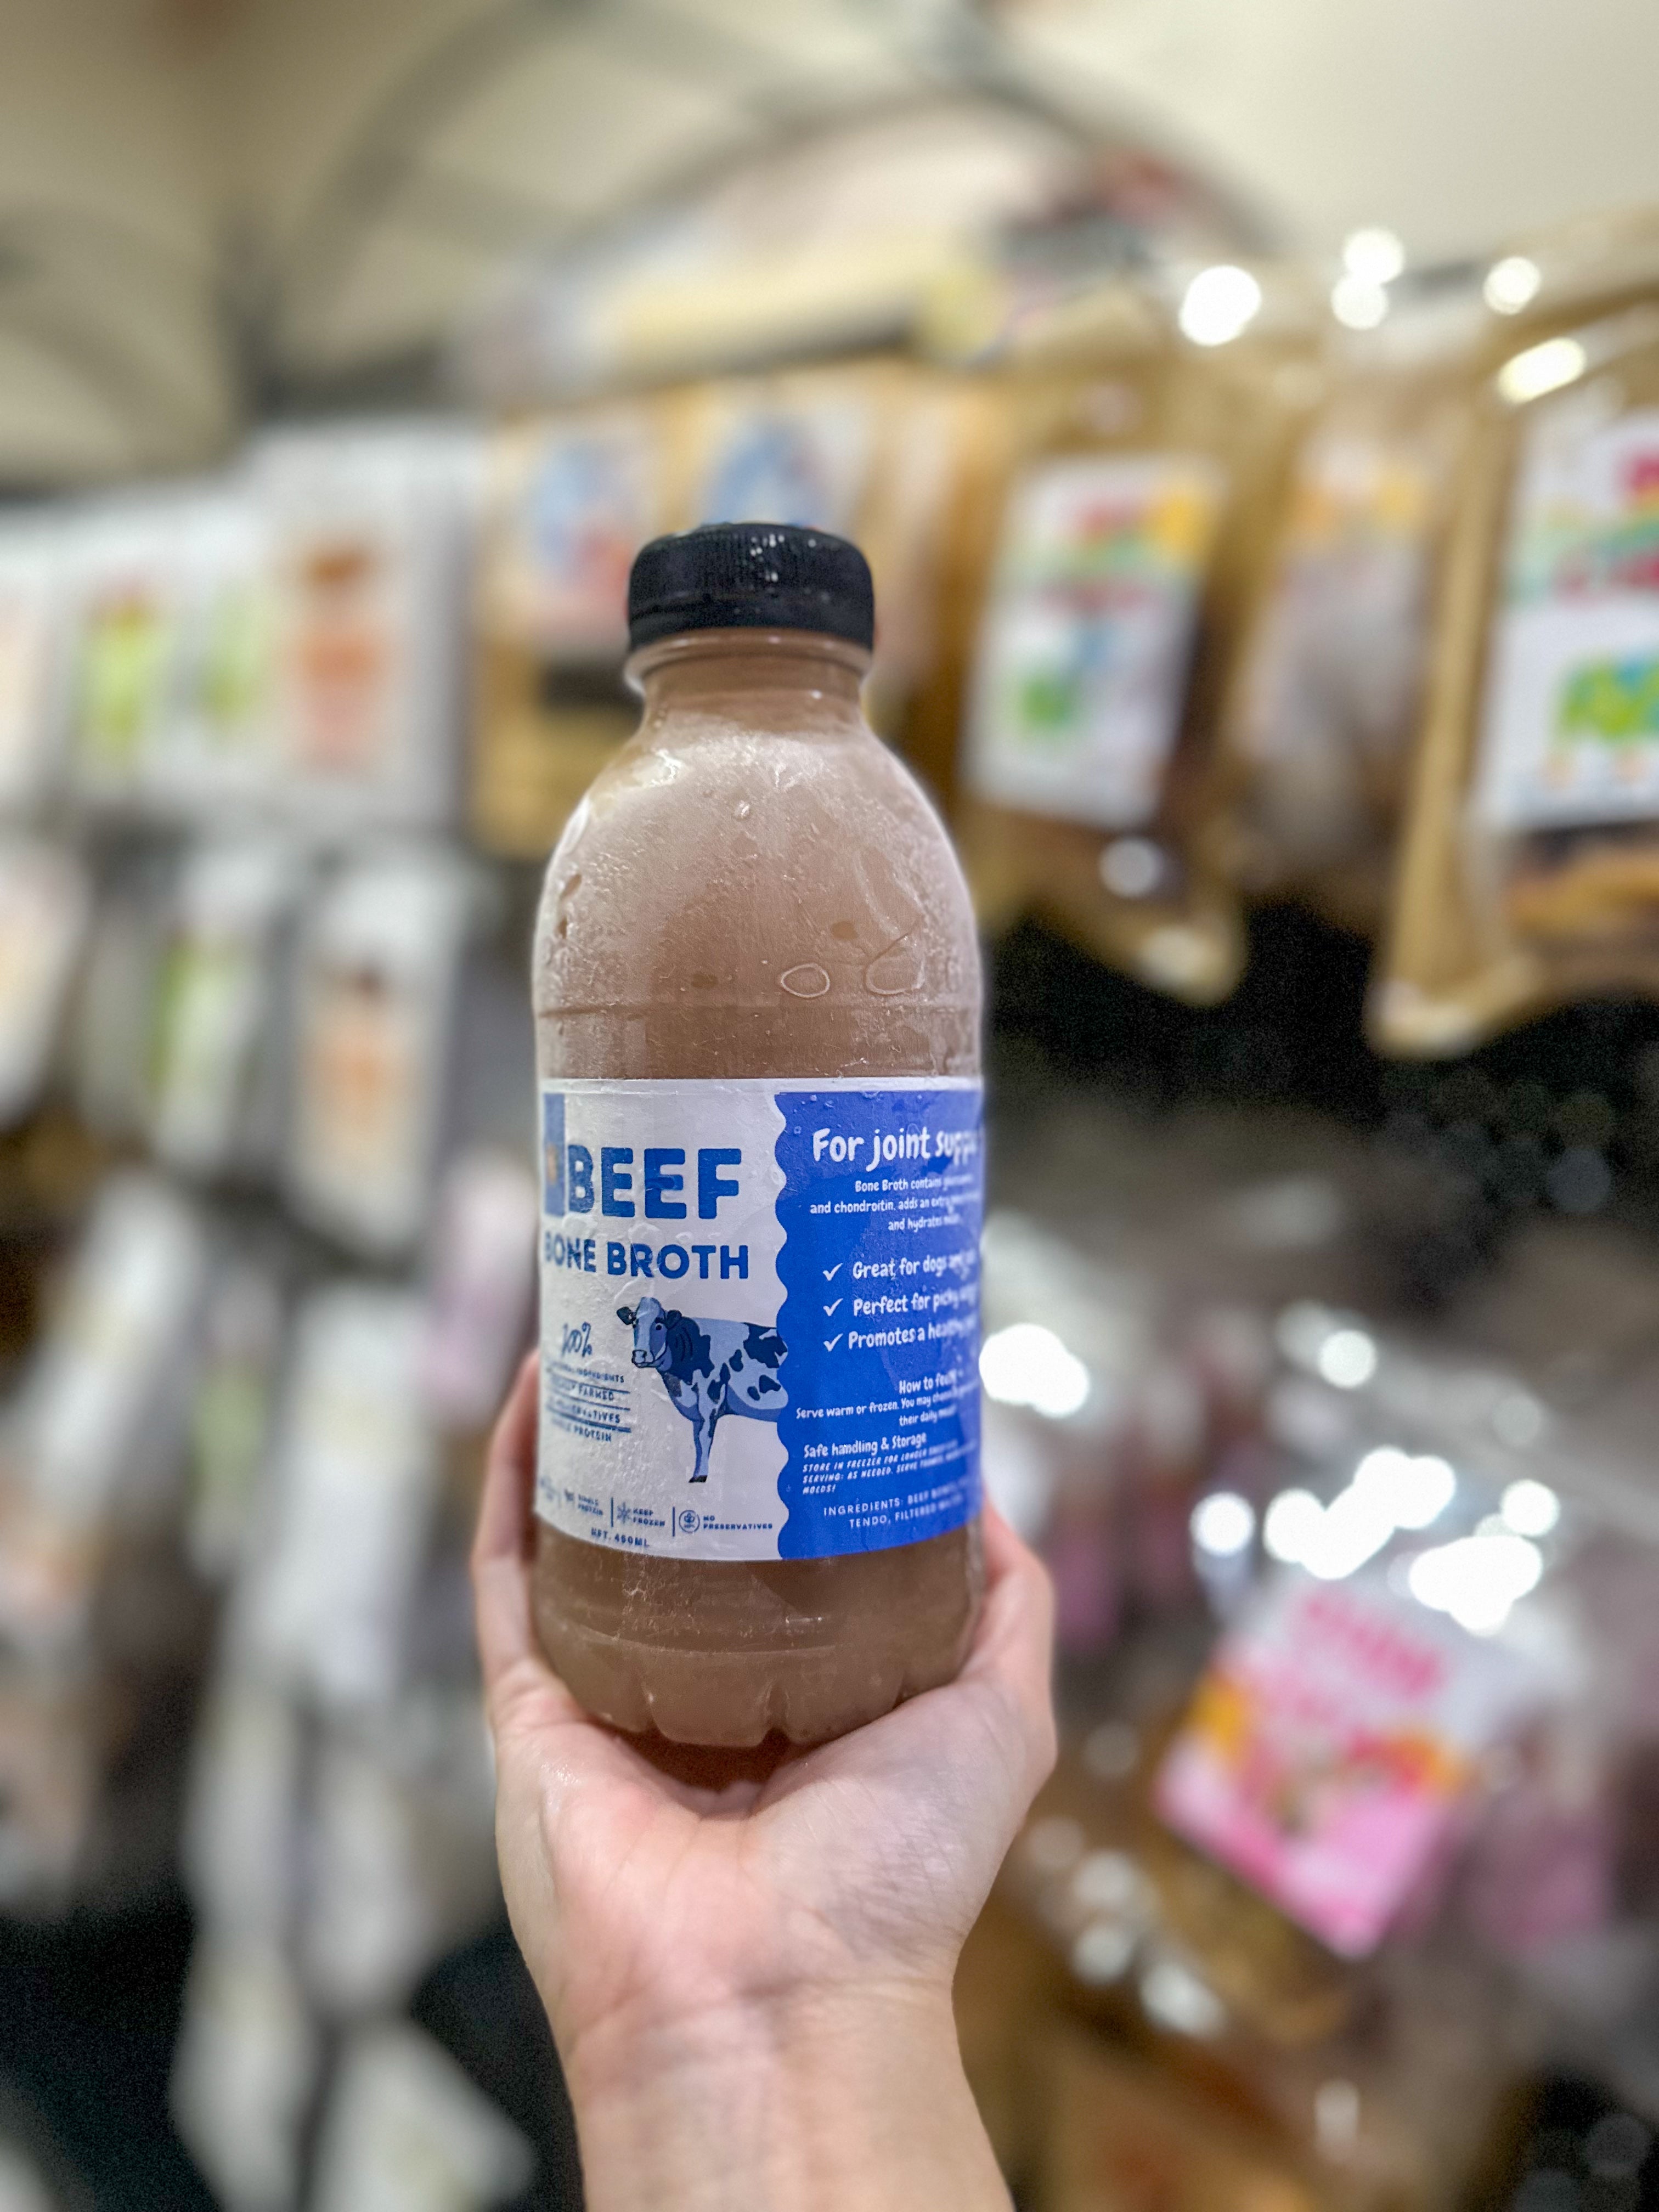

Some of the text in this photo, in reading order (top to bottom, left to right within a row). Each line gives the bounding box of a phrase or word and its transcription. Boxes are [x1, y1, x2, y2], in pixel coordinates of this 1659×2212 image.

[812, 1127, 865, 1162] For
[866, 1126, 930, 1172] joint
[568, 1144, 742, 1219] BEEF
[855, 1180, 879, 1193] Bone
[882, 1178, 909, 1191] Broth
[810, 1200, 831, 1214] and
[898, 1195, 918, 1210] adds
[919, 1198, 929, 1209] an
[888, 1217, 905, 1231] and
[545, 1231, 748, 1279] BONE BROTH
[853, 1257, 896, 1280] Great
[899, 1257, 921, 1276] for
[854, 1294, 909, 1317] Perfect
[911, 1292, 931, 1311] for
[848, 1327, 926, 1350] Promotes a
[579, 1383, 614, 1401] FARMED
[899, 1379, 921, 1395] How
[923, 1375, 933, 1390] to
[796, 1407, 824, 1419] Serve
[826, 1406, 854, 1417] warm
[856, 1405, 867, 1414] or
[869, 1402, 900, 1413] frozen.
[901, 1397, 915, 1409] You
[916, 1396, 931, 1408] may
[899, 1414, 919, 1426] their
[574, 1425, 612, 1442] PROTEIN
[804, 1443, 828, 1458] Safe
[832, 1440, 878, 1456] handling
[881, 1437, 889, 1450] &
[891, 1432, 927, 1449] Storage
[803, 1462, 831, 1473] STORE
[833, 1461, 844, 1470] IN
[847, 1457, 881, 1469] FREEZER
[884, 1454, 899, 1464] FOR
[847, 1470, 858, 1480] AS
[633, 1509, 653, 1517] KEEP
[633, 1517, 665, 1527] FROZEN
[850, 1515, 891, 1528] TENDO,
